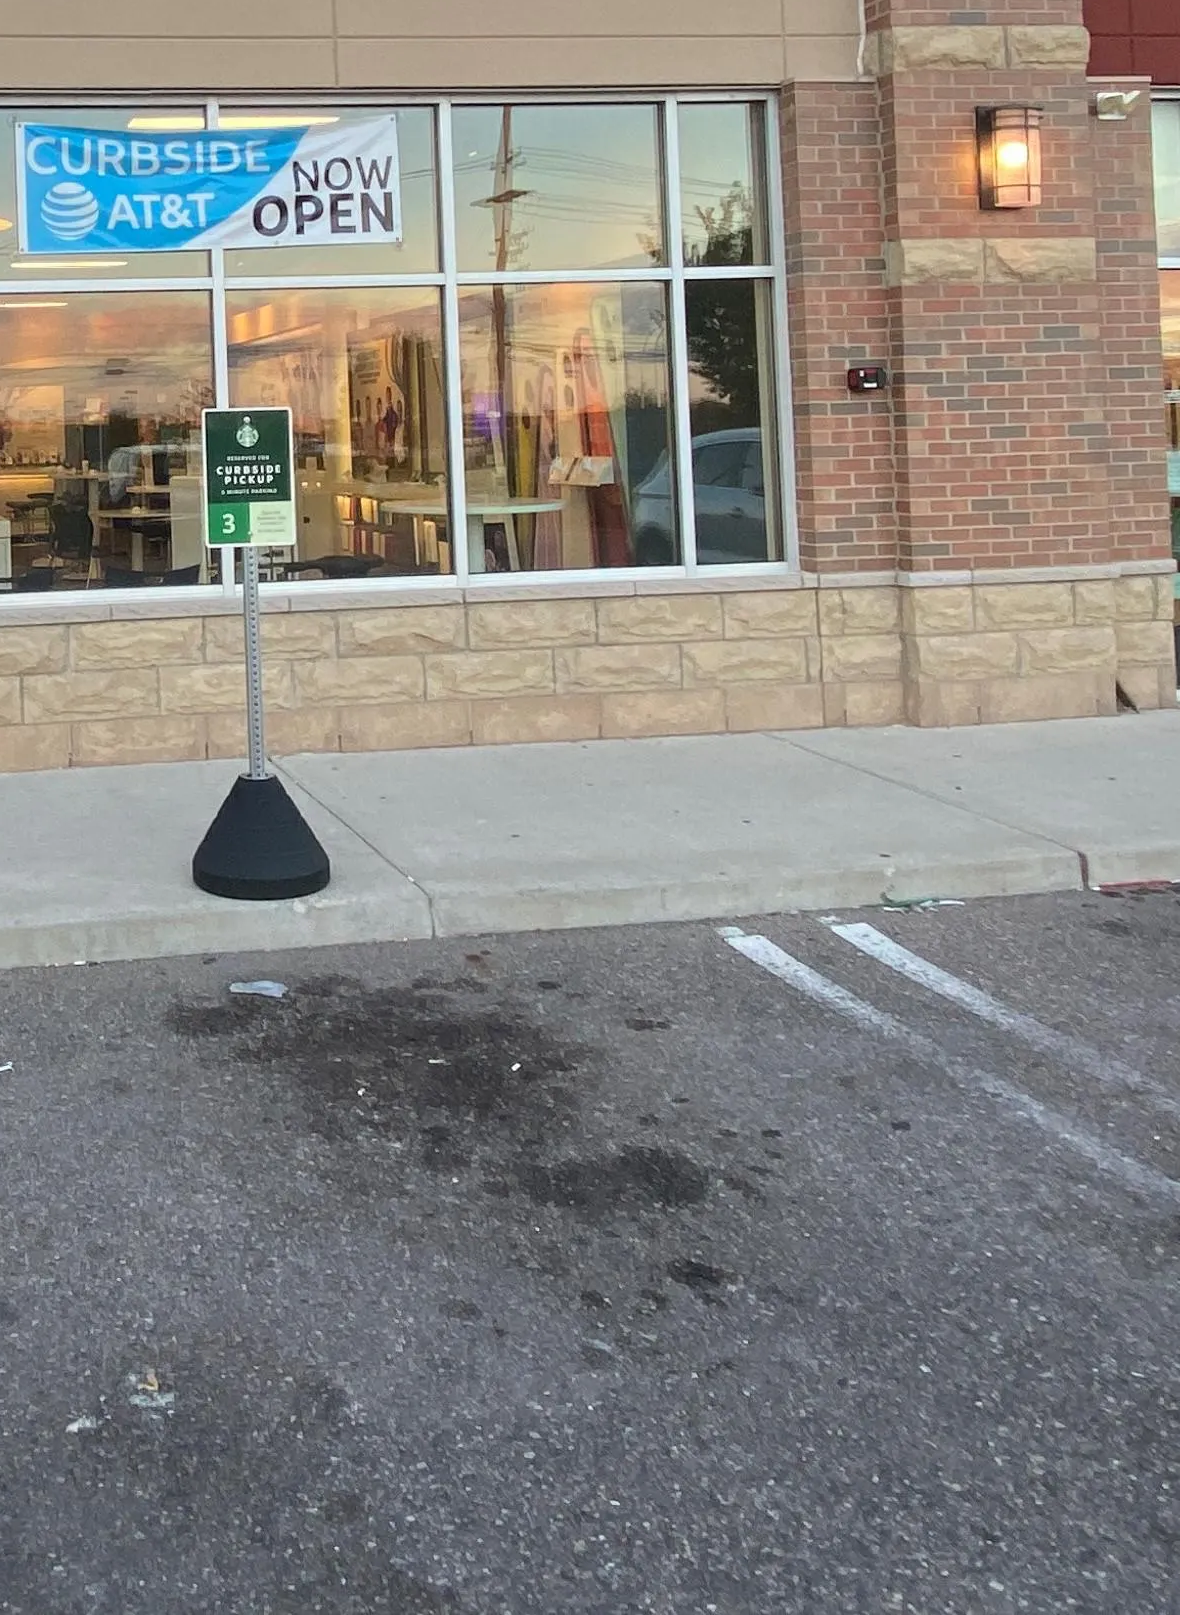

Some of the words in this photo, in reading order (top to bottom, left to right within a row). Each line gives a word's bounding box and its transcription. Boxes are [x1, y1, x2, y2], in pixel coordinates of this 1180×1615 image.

[27, 136, 271, 177] CURBSIDE
[292, 155, 393, 193] NOW
[107, 192, 215, 231] AT&T
[252, 191, 395, 238] OPEN
[216, 464, 281, 475] CURBSIDE
[224, 474, 274, 485] PICKUP
[222, 513, 236, 534] 3
